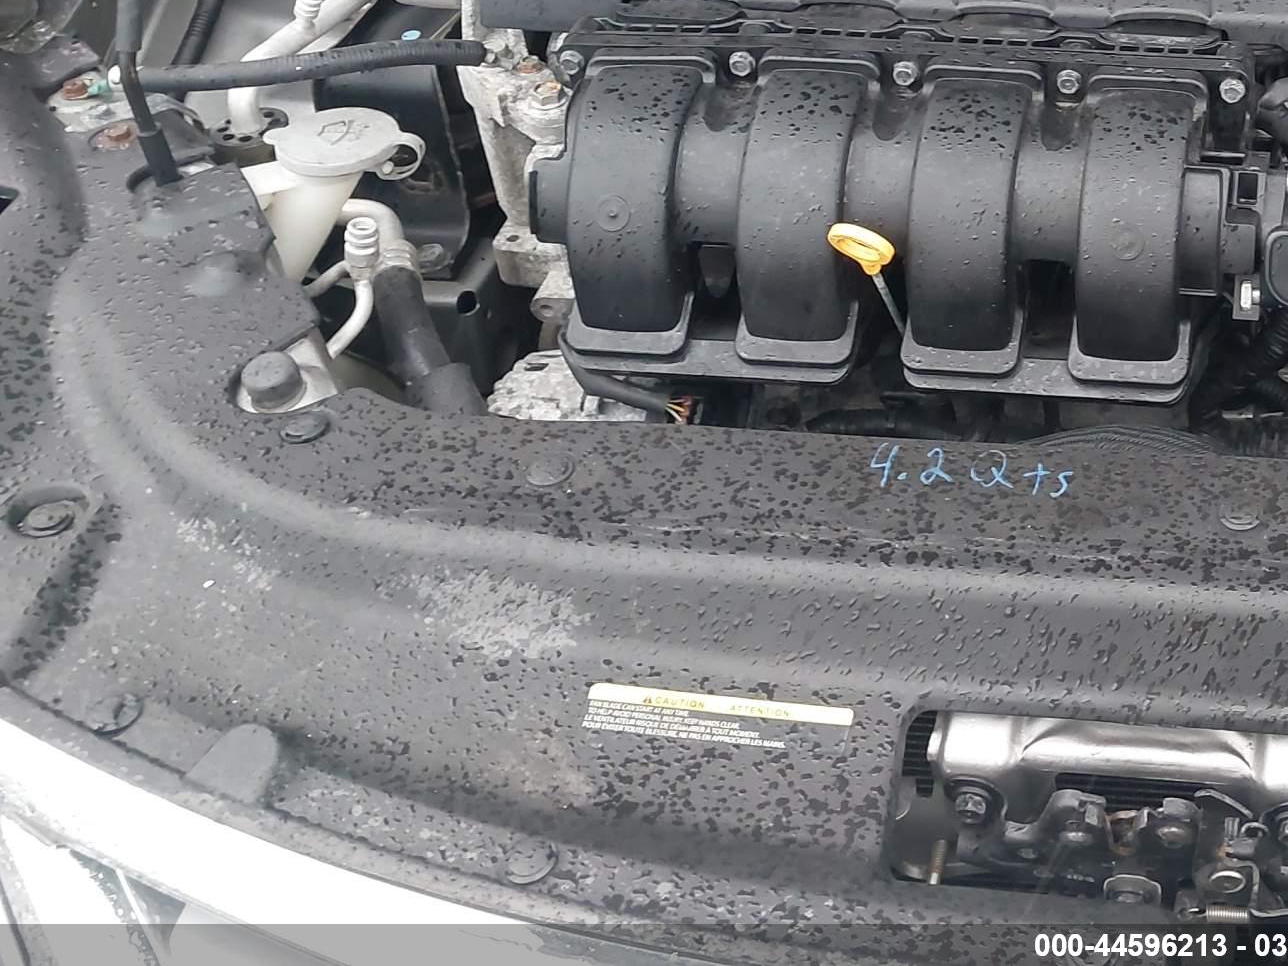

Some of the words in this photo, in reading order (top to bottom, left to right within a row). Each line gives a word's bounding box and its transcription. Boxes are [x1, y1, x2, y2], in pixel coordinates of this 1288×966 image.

[869, 442, 953, 487] 4.2
[970, 449, 1075, 498] Qts
[655, 696, 705, 709] CAUTION
[730, 705, 791, 717] ATTENTION
